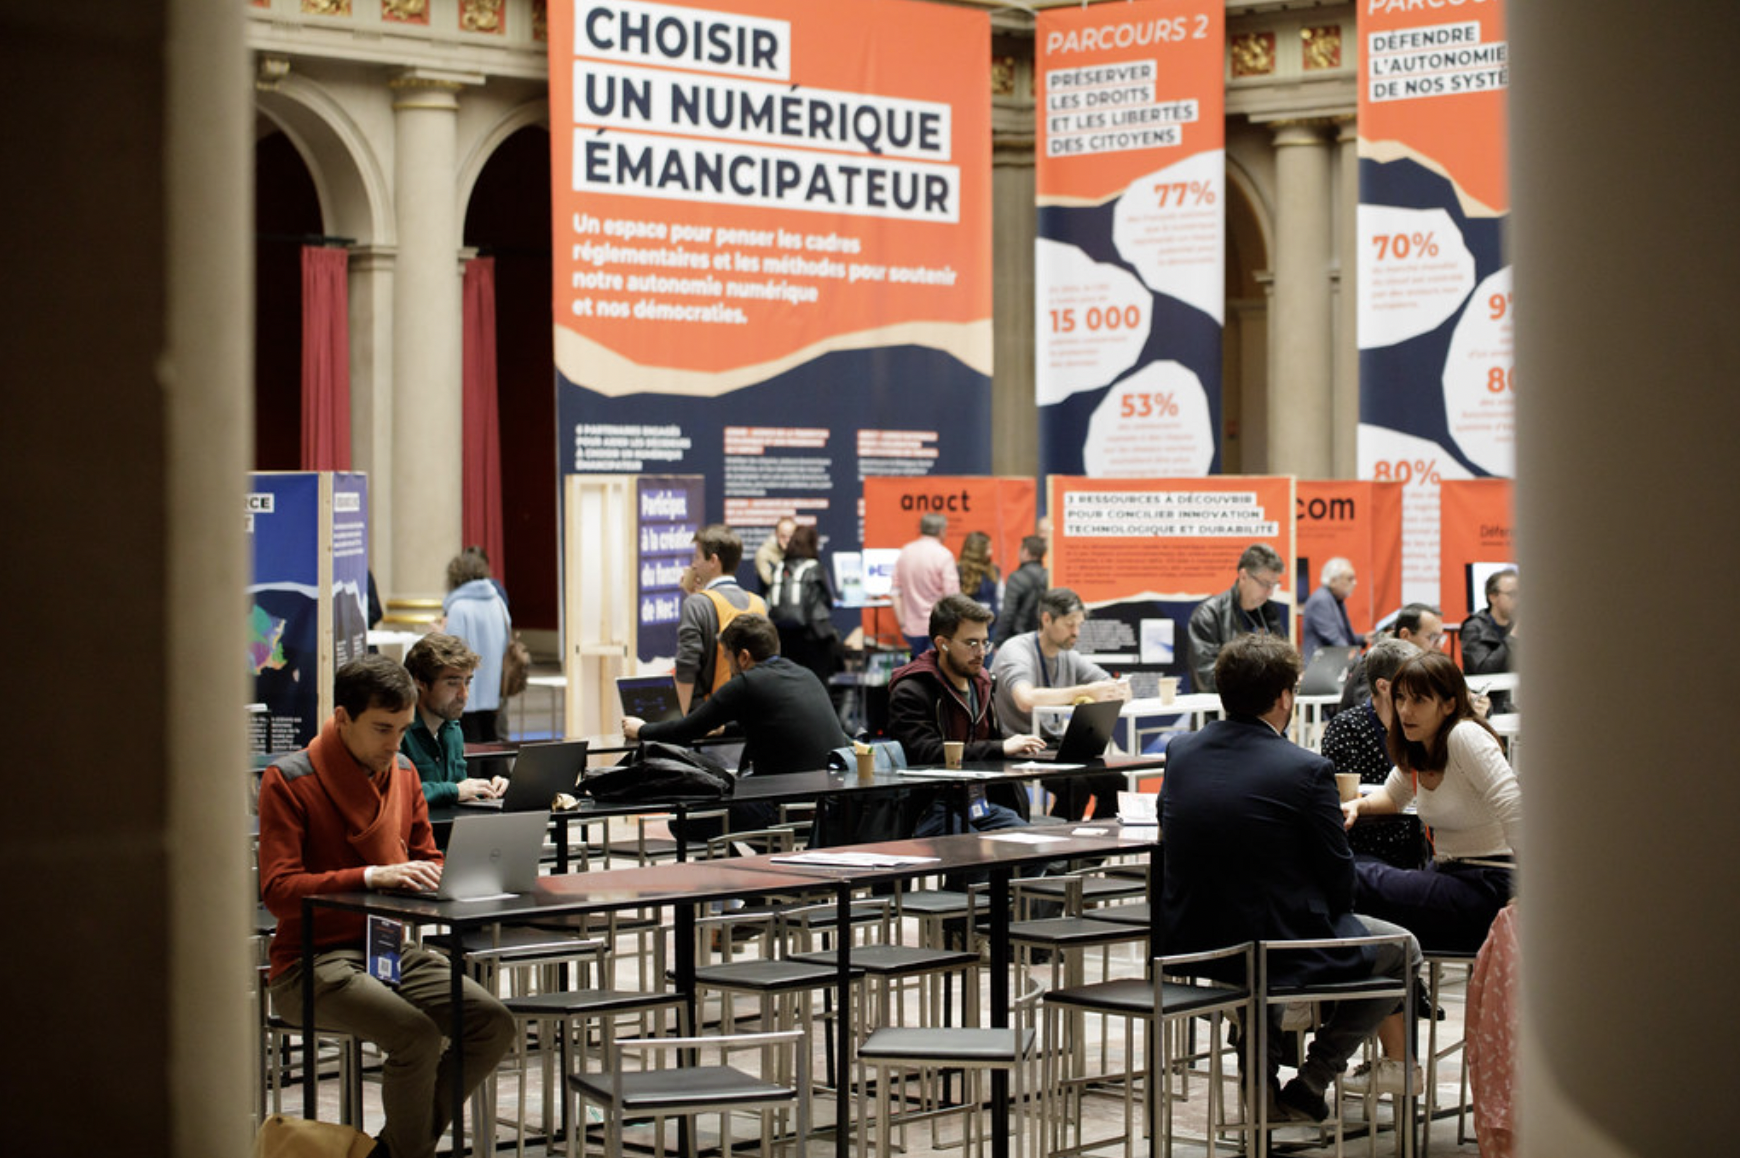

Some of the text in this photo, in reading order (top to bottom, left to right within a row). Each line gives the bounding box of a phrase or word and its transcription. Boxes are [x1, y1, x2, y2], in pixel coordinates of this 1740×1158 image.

[586, 8, 778, 70] CHOISIR
[1046, 14, 1209, 55] PARCOURS 2
[1374, 26, 1475, 51] DÉFENDRE
[1374, 44, 1507, 75] L'AUTONOMIE
[1051, 87, 1149, 110] LES DROITS
[1375, 82, 1398, 98] DE
[1405, 76, 1444, 94] NOS
[585, 73, 941, 155] UN NUMÉRIQUE
[1052, 117, 1069, 132] ET
[1077, 114, 1106, 129] LES
[1052, 129, 1175, 153] DES CITOYENS
[585, 128, 949, 213] ÉMANCIPATEUR
[1154, 180, 1216, 208] 77%
[573, 213, 860, 254] Un espace pour penser les cadres
[1372, 232, 1439, 261] 70%
[572, 239, 957, 286] réglementaires et les méthodes pour soutenir
[572, 271, 818, 305] notre autonomie numérique
[572, 297, 748, 324] et nos démocraties.
[1050, 304, 1140, 333] 15 000
[1488, 292, 1513, 320] 9
[1121, 392, 1179, 418] 53%
[1374, 459, 1441, 486] 80%
[1078, 494, 1160, 503] RESSOURCES
[1068, 510, 1103, 519] POUR
[1178, 510, 1260, 519] INNOVATION
[1068, 524, 1175, 536] TECHNOLOGIQUE
[1180, 525, 1194, 533] ET
